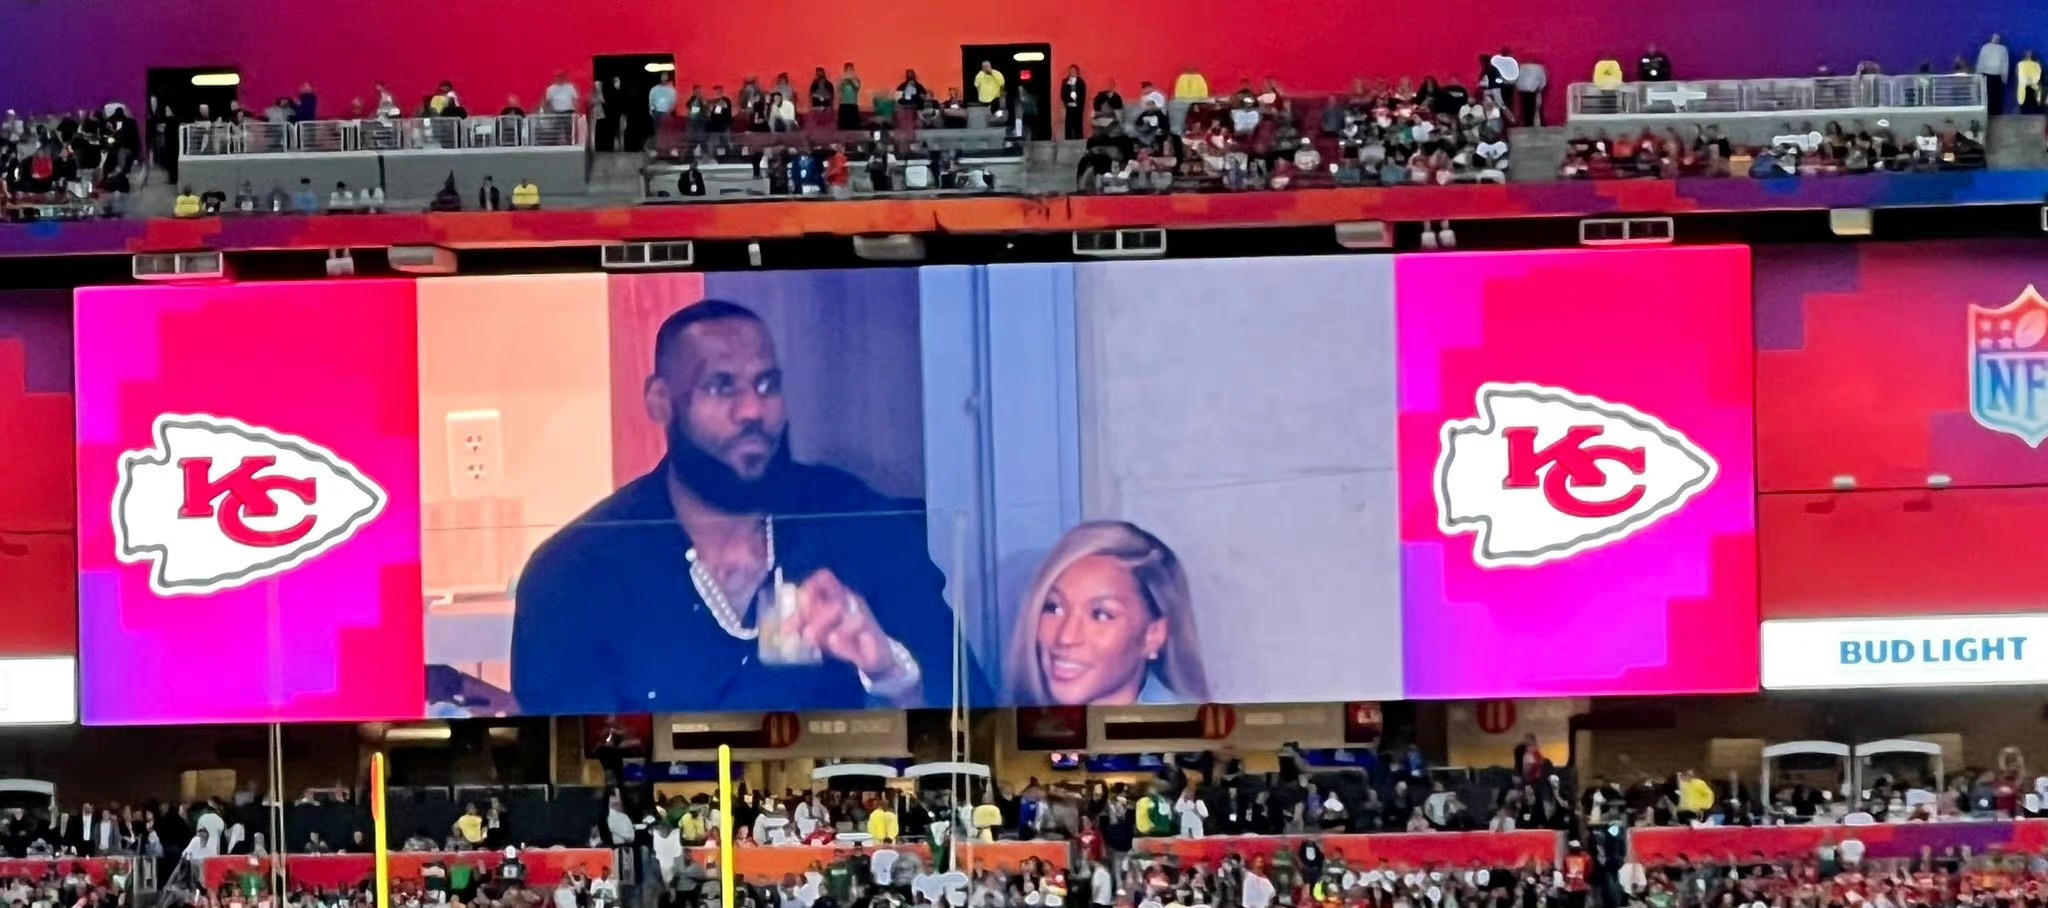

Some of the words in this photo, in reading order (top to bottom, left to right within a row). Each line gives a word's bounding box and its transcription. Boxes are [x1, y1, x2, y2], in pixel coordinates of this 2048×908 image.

[177, 455, 318, 547] KC
[1502, 425, 1646, 518] KC
[1840, 640, 1915, 664] BUD
[1922, 637, 2028, 662] LIGHT
